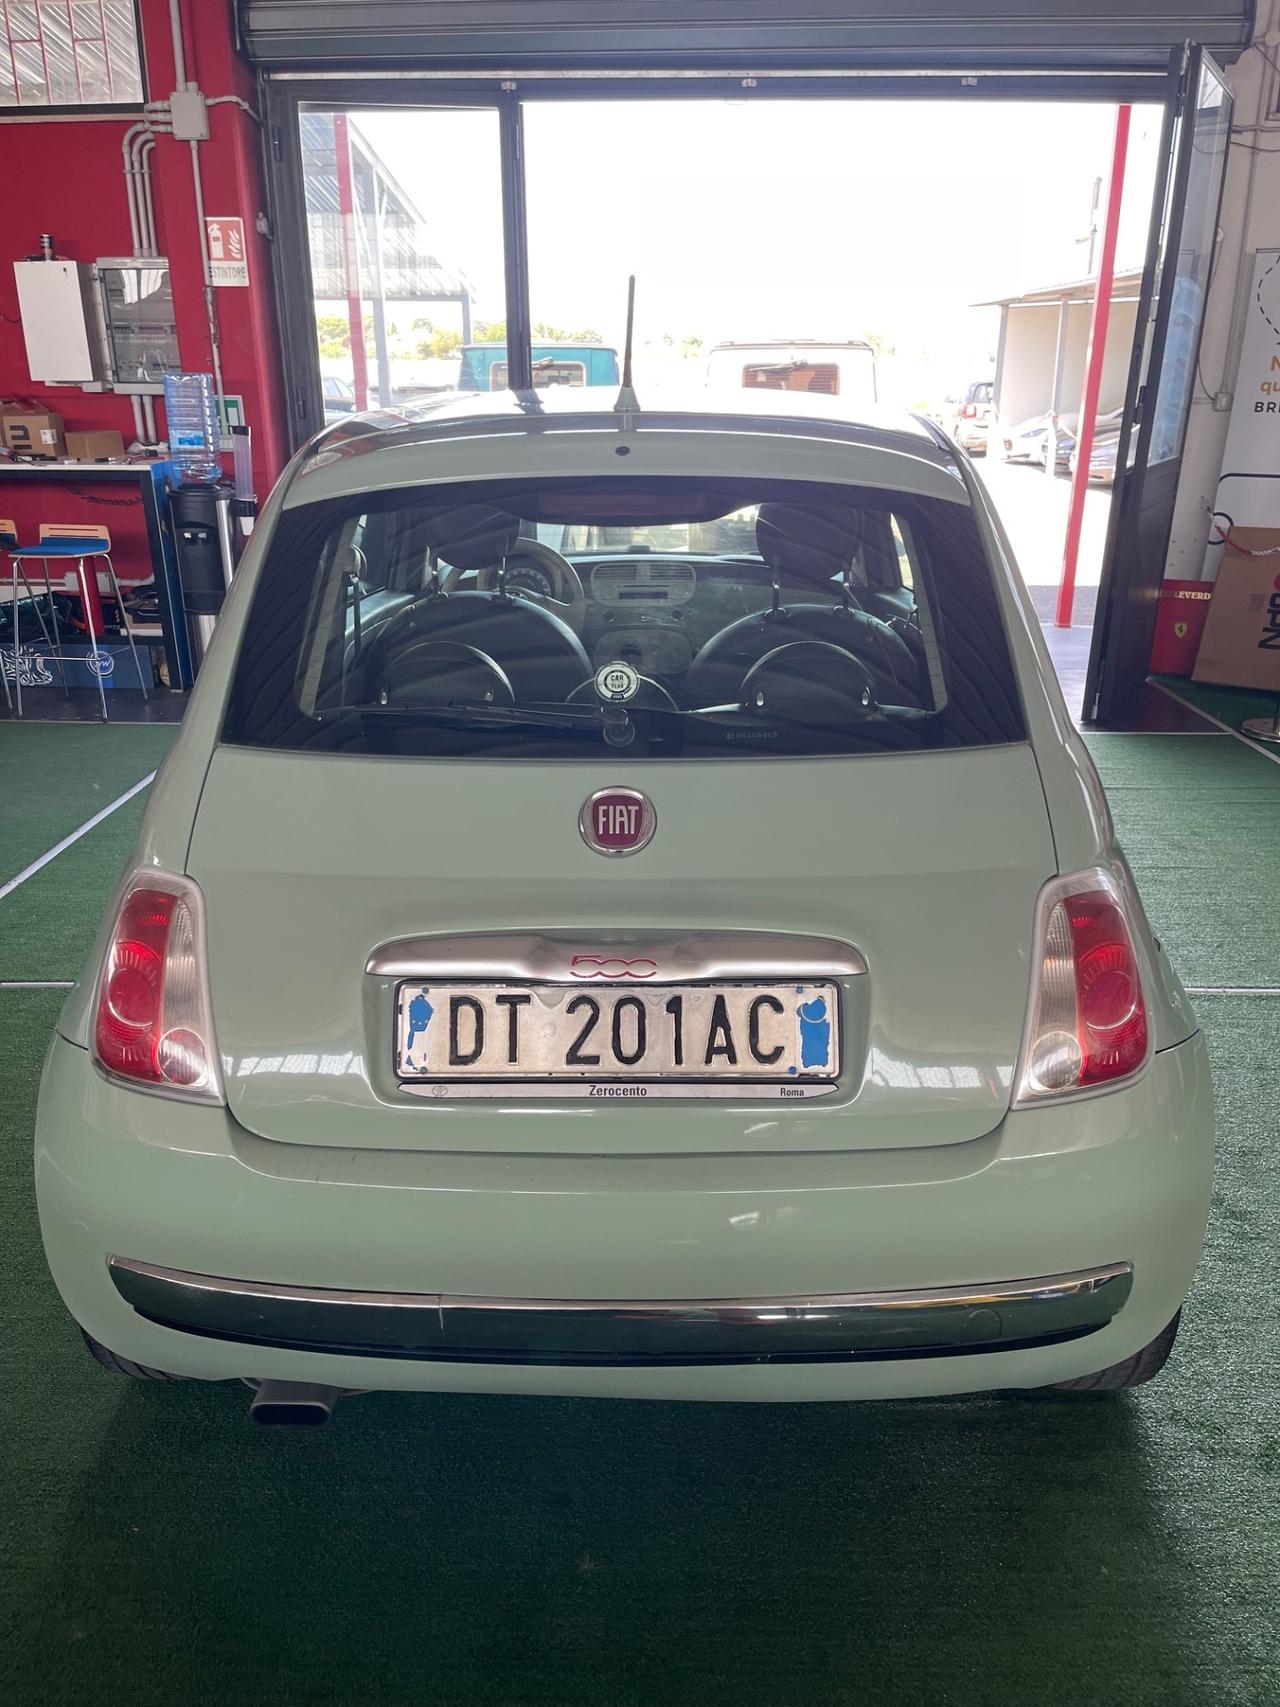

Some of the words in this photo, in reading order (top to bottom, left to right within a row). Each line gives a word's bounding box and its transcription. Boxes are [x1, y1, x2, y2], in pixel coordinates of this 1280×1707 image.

[598, 805, 640, 835] FIAT
[568, 954, 659, 979] 500
[449, 994, 531, 1065] DT
[565, 994, 785, 1066] 201AC
[589, 1084, 648, 1096] Zerocento
[780, 1087, 805, 1097] Roma
